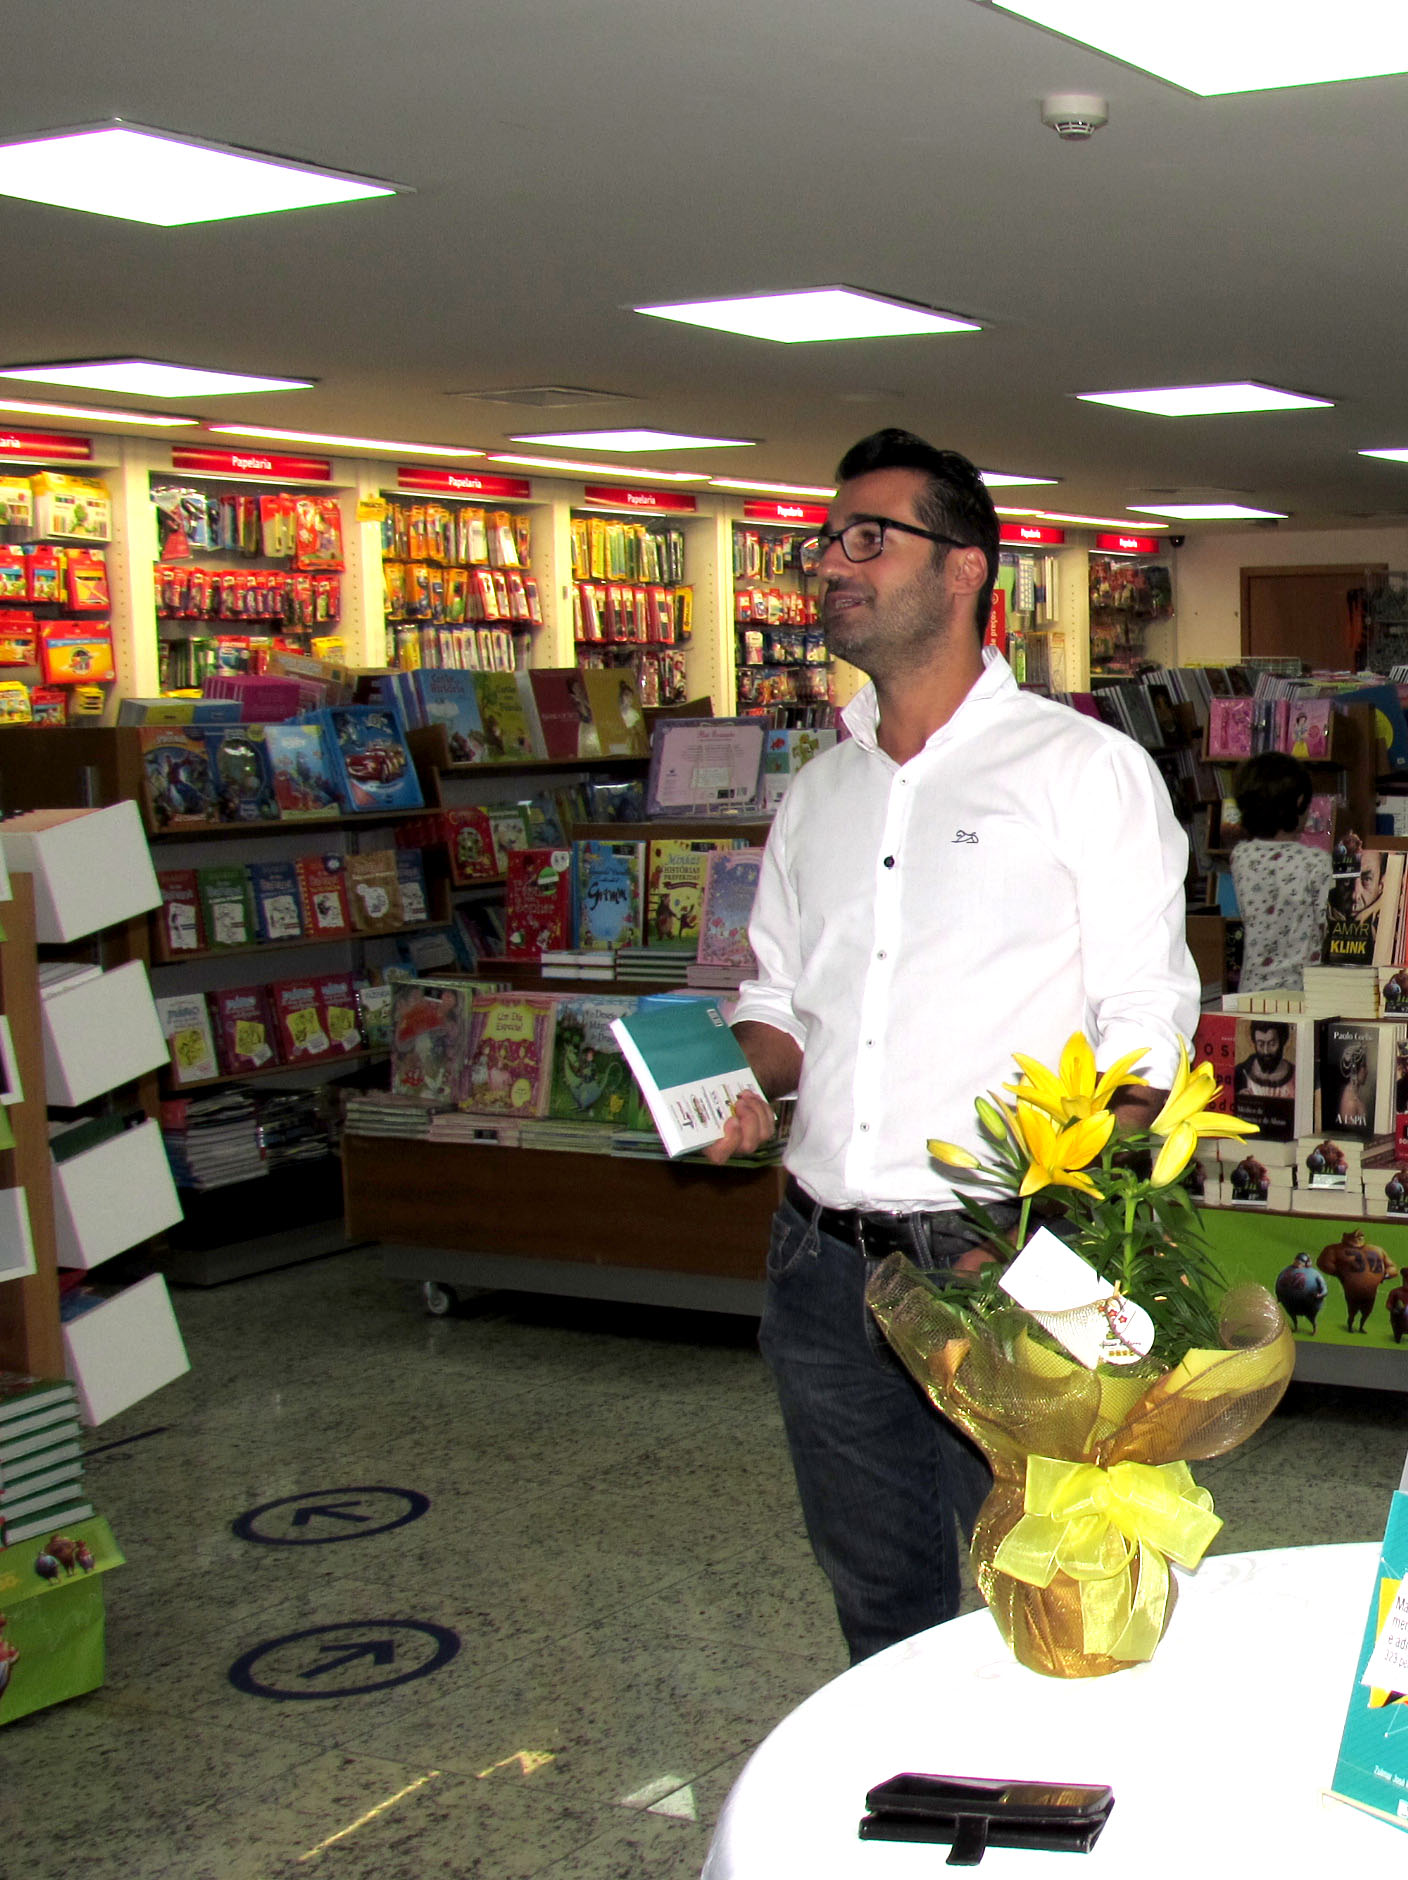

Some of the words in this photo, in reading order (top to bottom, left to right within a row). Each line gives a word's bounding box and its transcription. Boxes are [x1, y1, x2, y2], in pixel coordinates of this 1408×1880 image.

[232, 456, 272, 470] Papelaria
[448, 476, 482, 489] Papelaria
[627, 494, 656, 505] Papelaria
[777, 505, 803, 517] Papelaria
[588, 880, 628, 911] Grimm
[1333, 922, 1370, 936] AMYR
[1330, 940, 1367, 954] KLINK
[1333, 1031, 1353, 1041] Paulo
[1335, 1113, 1343, 1125] A
[1388, 1635, 1394, 1645] e
